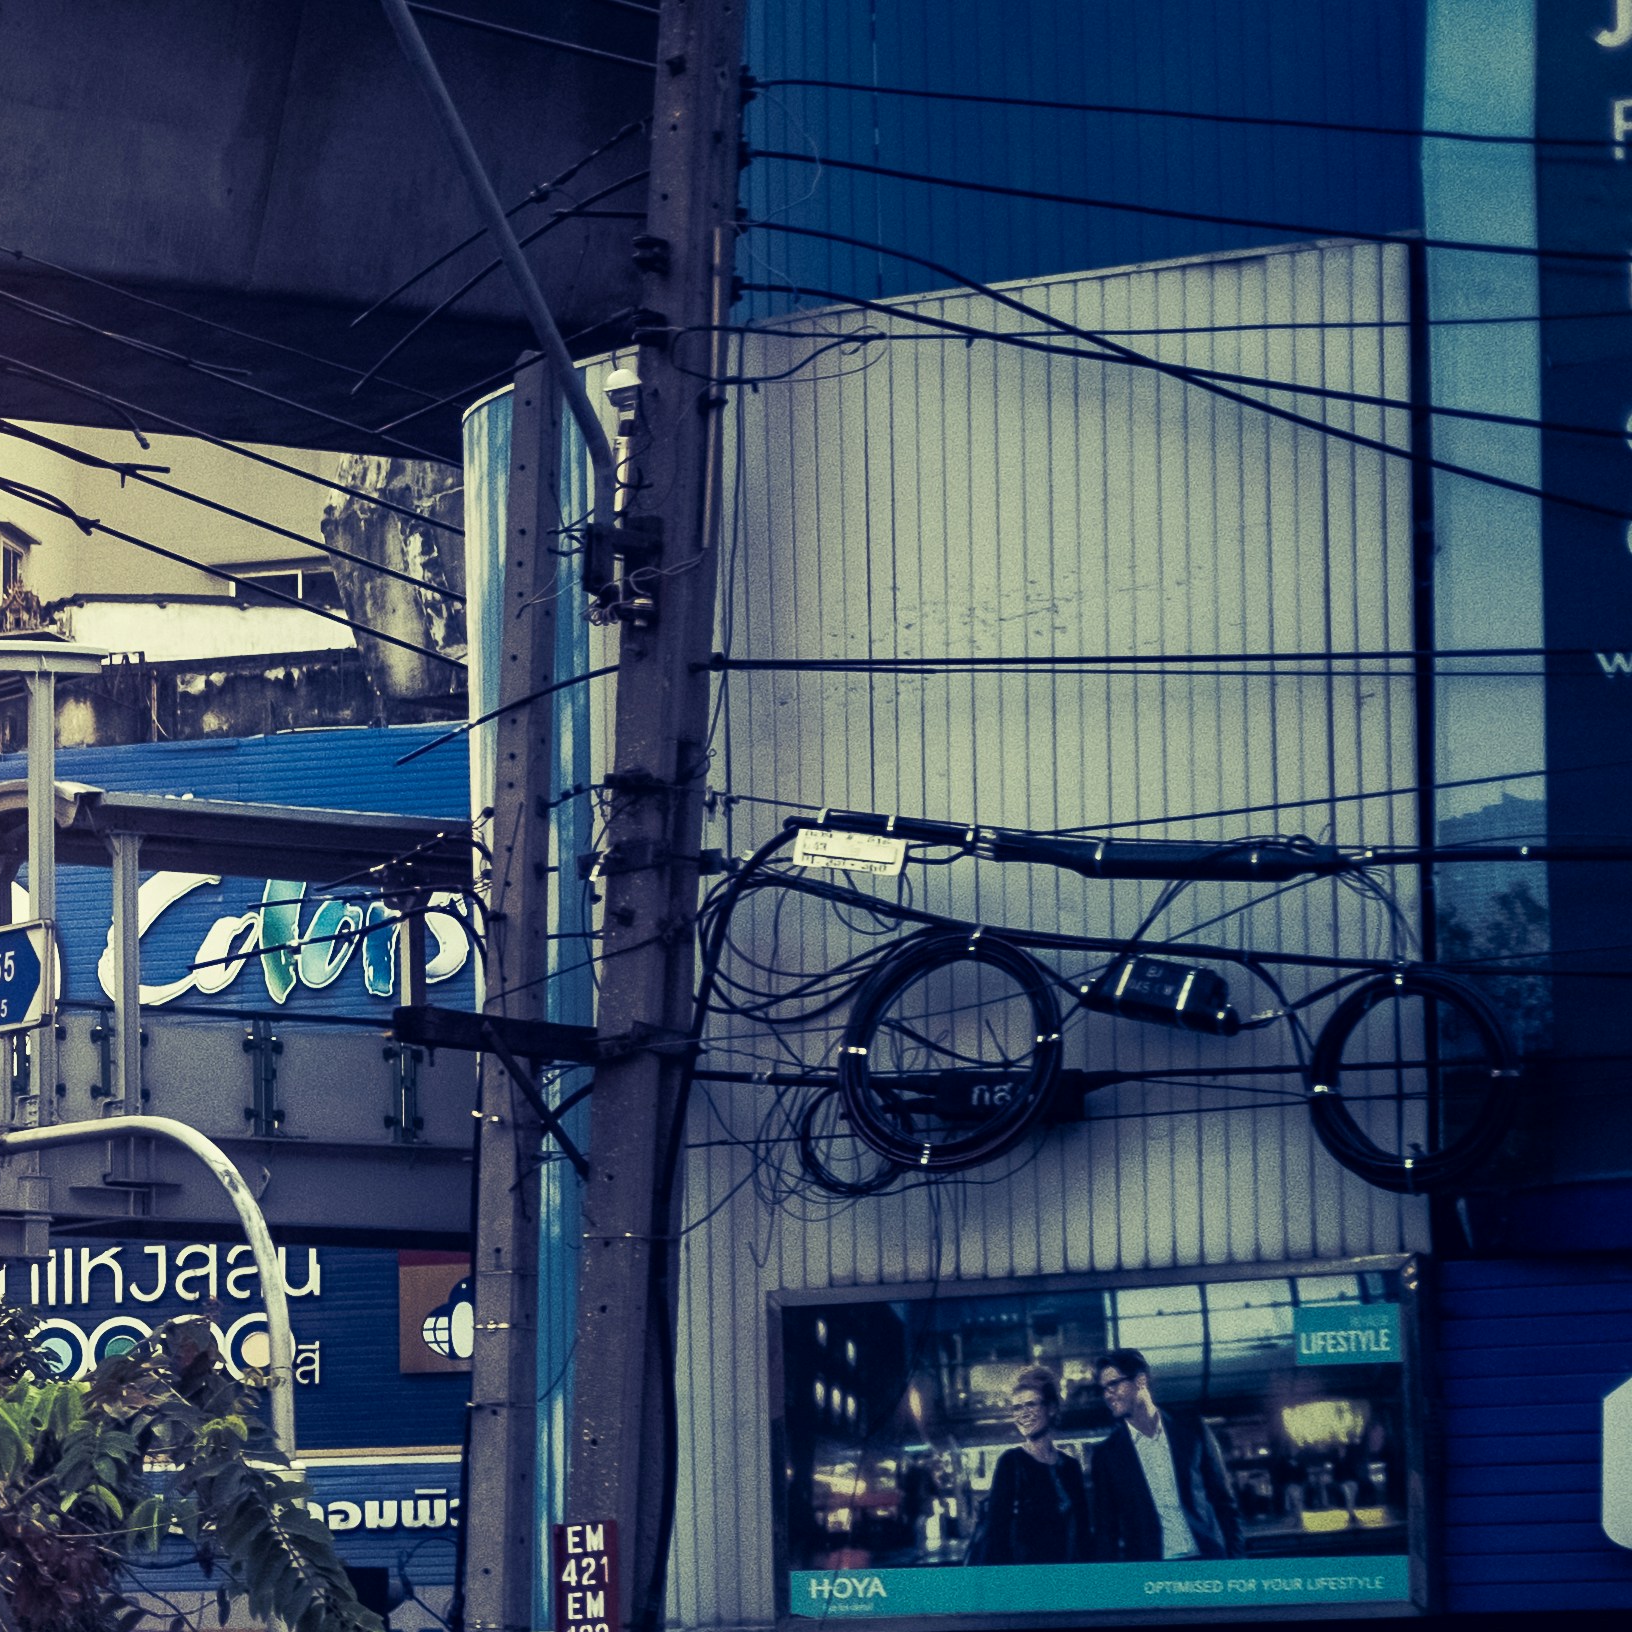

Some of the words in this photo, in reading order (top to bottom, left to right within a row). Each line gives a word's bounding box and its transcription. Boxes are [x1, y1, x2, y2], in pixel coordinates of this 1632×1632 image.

[1300, 1328, 1391, 1354] LIFESTYLE
[568, 1525, 604, 1553] EM
[562, 1557, 610, 1585] 421
[808, 1576, 887, 1599] HOYA
[1144, 1580, 1224, 1595] OPTIMISED
[1227, 1578, 1256, 1593] FOR
[1261, 1577, 1302, 1592] YOUR
[1306, 1575, 1385, 1591] LIFESTYLE
[568, 1592, 604, 1620] EM
